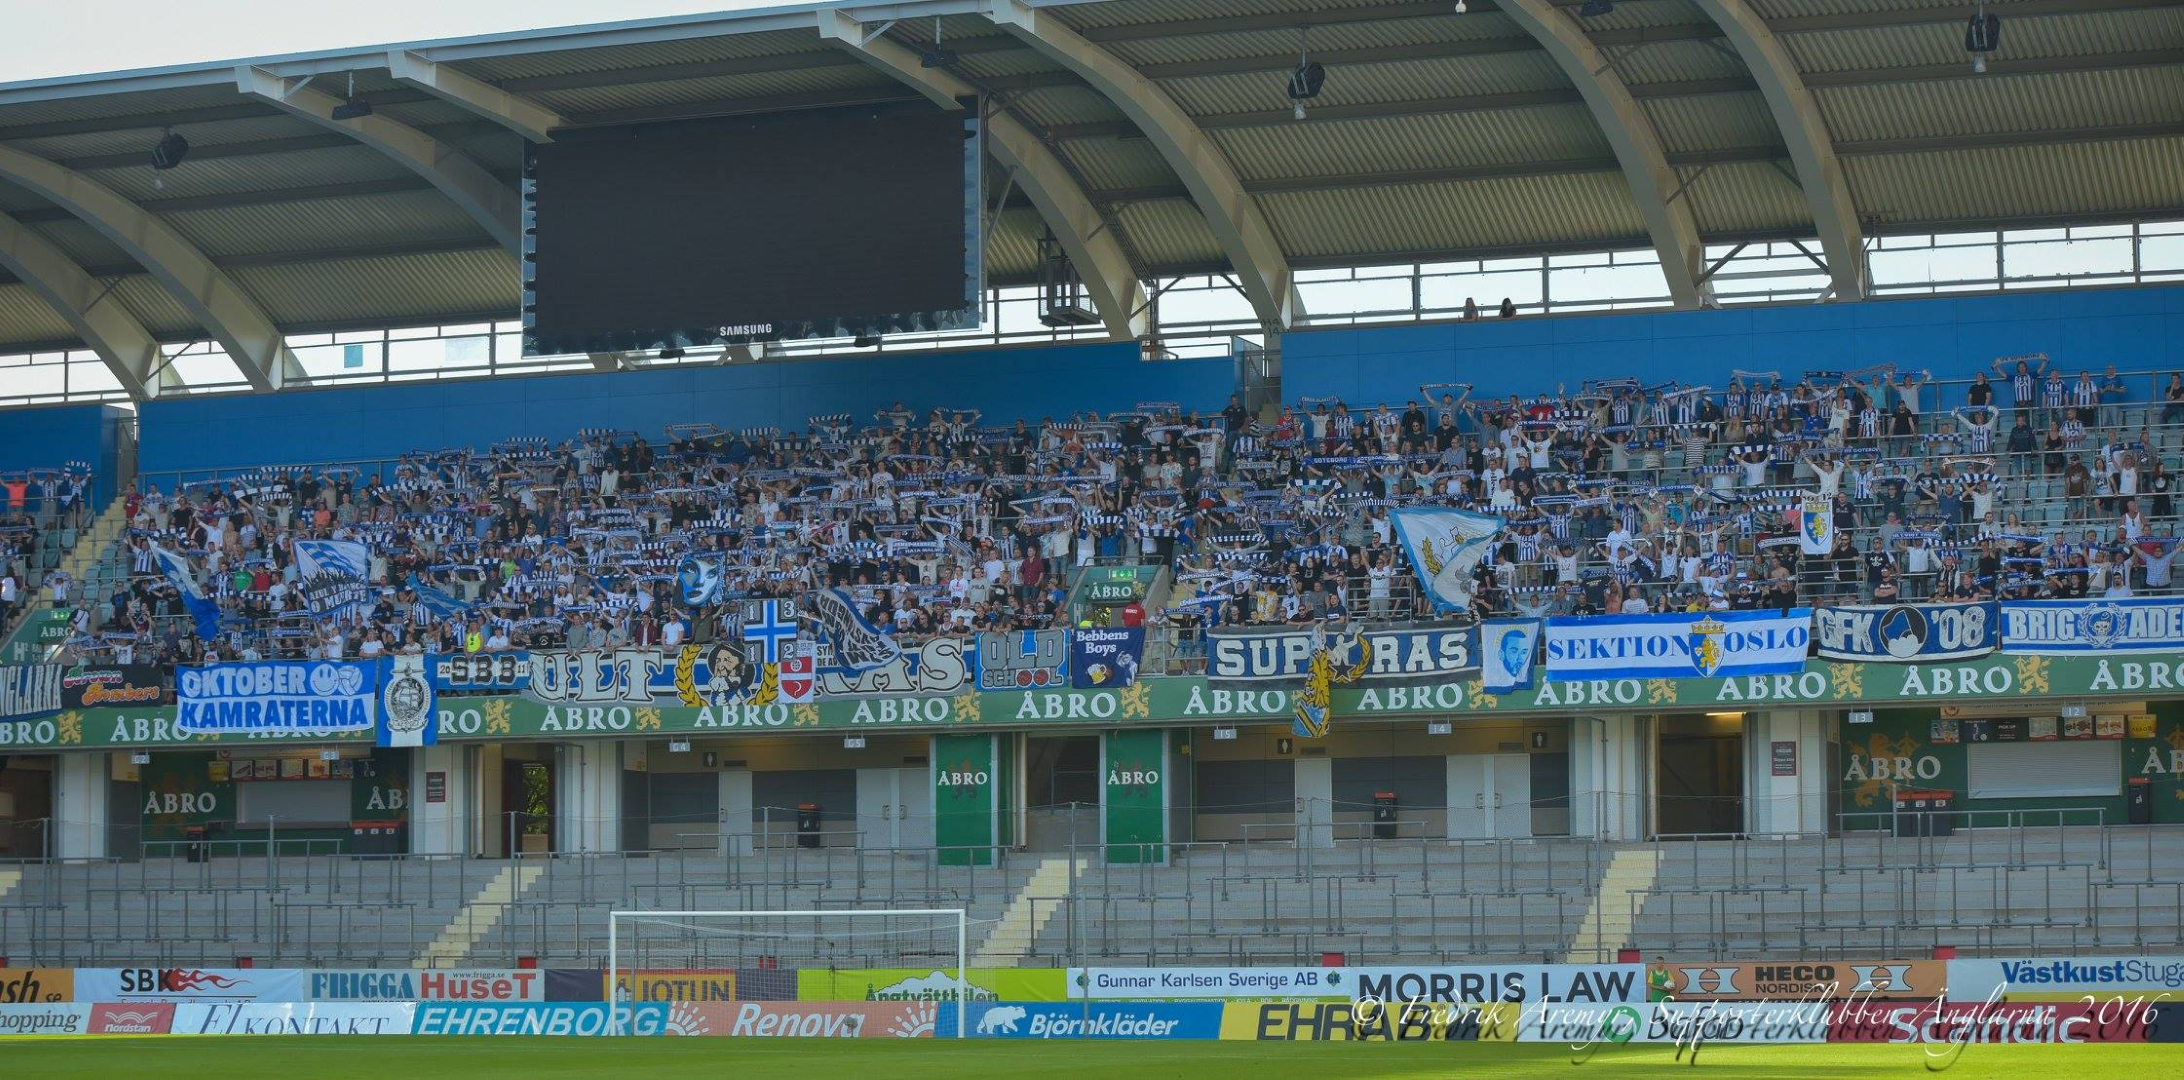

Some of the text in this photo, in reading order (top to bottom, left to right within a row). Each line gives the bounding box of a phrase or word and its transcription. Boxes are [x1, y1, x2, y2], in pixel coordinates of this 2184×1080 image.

[720, 323, 772, 336] SAMSUNG
[1091, 581, 1132, 598] ÅBRO
[747, 600, 795, 620] 1 3
[2127, 607, 2184, 639] ADE
[1076, 630, 1129, 643] Bebbens
[1548, 625, 1808, 661] SEKTION OSLO
[1817, 607, 1874, 653] GFK
[749, 643, 794, 661] 1 2
[981, 631, 1065, 669] OLD
[1085, 642, 1117, 656] Boys
[181, 666, 306, 698] OKTOBER
[449, 655, 519, 686] SBB
[982, 667, 1064, 687] SCHOOL
[1900, 664, 2012, 696] ÅBRO
[180, 698, 368, 728] KAMRATERNA
[1016, 690, 1117, 719] ÅBRO
[1184, 685, 1286, 715] ÅBRO
[938, 770, 988, 786] ÅBRO
[1107, 769, 1159, 786] ÅBRO
[1844, 754, 1941, 781] ÅBRO
[144, 790, 217, 814] ÅBRO
[366, 785, 410, 810] ÅB
[120, 968, 175, 993] SBK
[311, 972, 537, 1000] FRIGGA HuseT
[1097, 972, 1156, 988] Gunnar
[1161, 972, 1223, 988] Karlsen
[1229, 971, 1288, 990] Sverige
[1294, 971, 1319, 986] AB
[1358, 971, 1636, 1003] MORRIS LAW
[1755, 965, 1836, 982] HECO
[1755, 982, 1835, 994] NORDISKA
[418, 1006, 662, 1037] EHRENBORG
[731, 1003, 866, 1038] Renova
[1029, 1012, 1179, 1039] Björnkläder
[1889, 1005, 2091, 1044] Scandic
